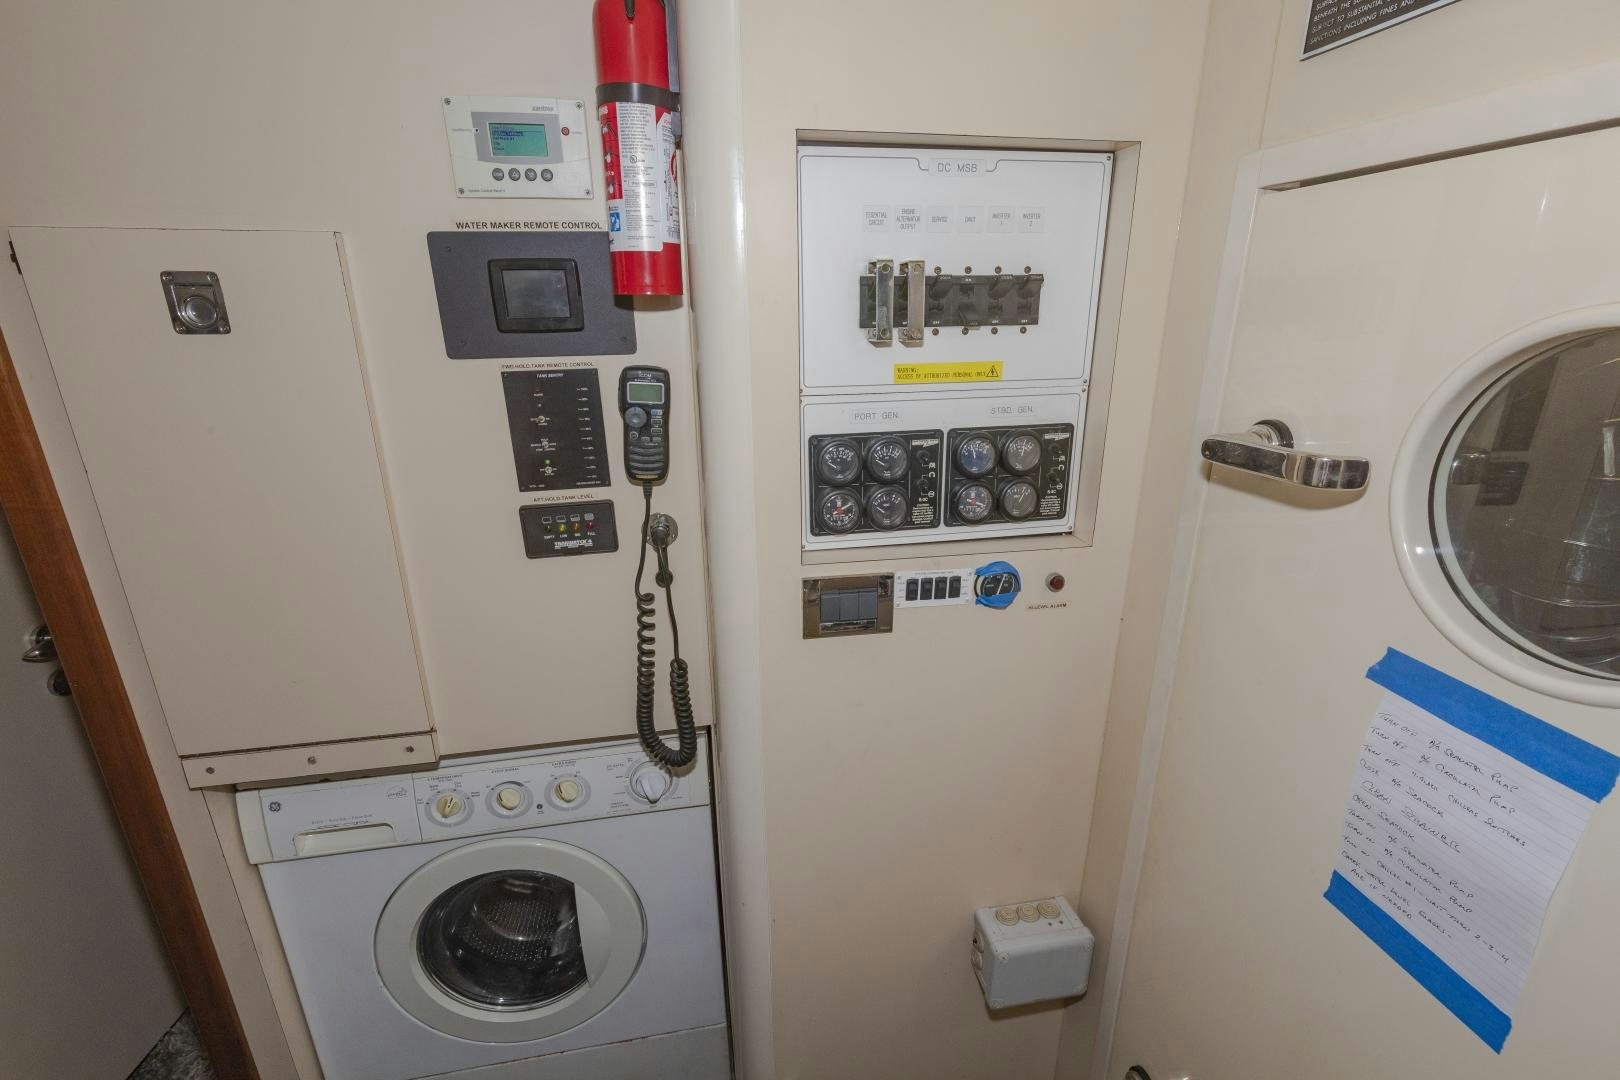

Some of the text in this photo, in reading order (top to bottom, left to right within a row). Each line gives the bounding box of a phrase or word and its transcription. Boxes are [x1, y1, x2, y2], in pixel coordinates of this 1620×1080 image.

[1314, 0, 1351, 22] BENEATH THE
[1337, 14, 1345, 22] TO
[1347, 0, 1383, 18] SUBSTANTIAL
[1343, 12, 1377, 31] INCLUDING
[1379, 3, 1398, 17] FINES
[937, 162, 978, 173] DC MSB
[561, 221, 601, 229] CONTROL
[854, 412, 876, 421] PORT
[1370, 726, 1390, 740] TURN
